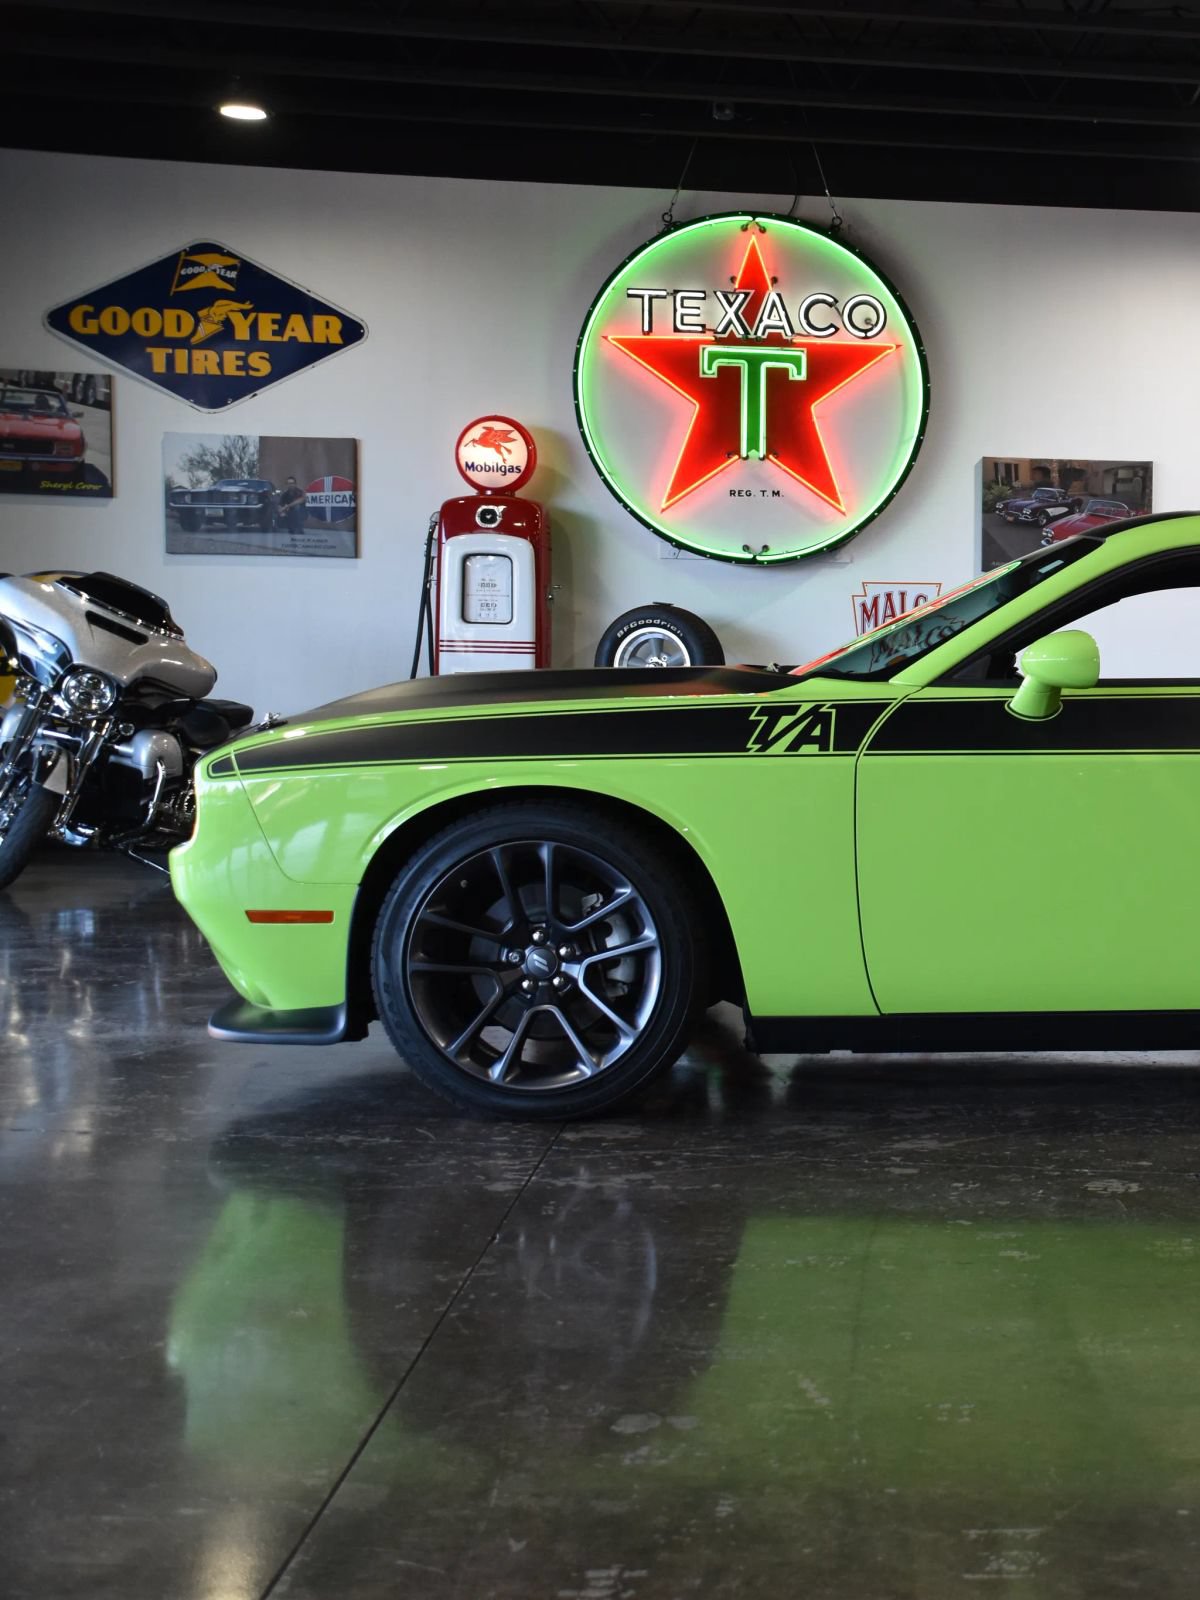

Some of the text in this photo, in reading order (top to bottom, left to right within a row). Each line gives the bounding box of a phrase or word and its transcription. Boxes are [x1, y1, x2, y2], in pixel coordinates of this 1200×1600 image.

[69, 304, 344, 344] GOOD YEAR
[627, 288, 888, 339] TEXACO
[146, 348, 272, 378] TIRES
[699, 344, 807, 460] T
[465, 461, 522, 476] Mobilgas
[729, 489, 756, 497] REG.
